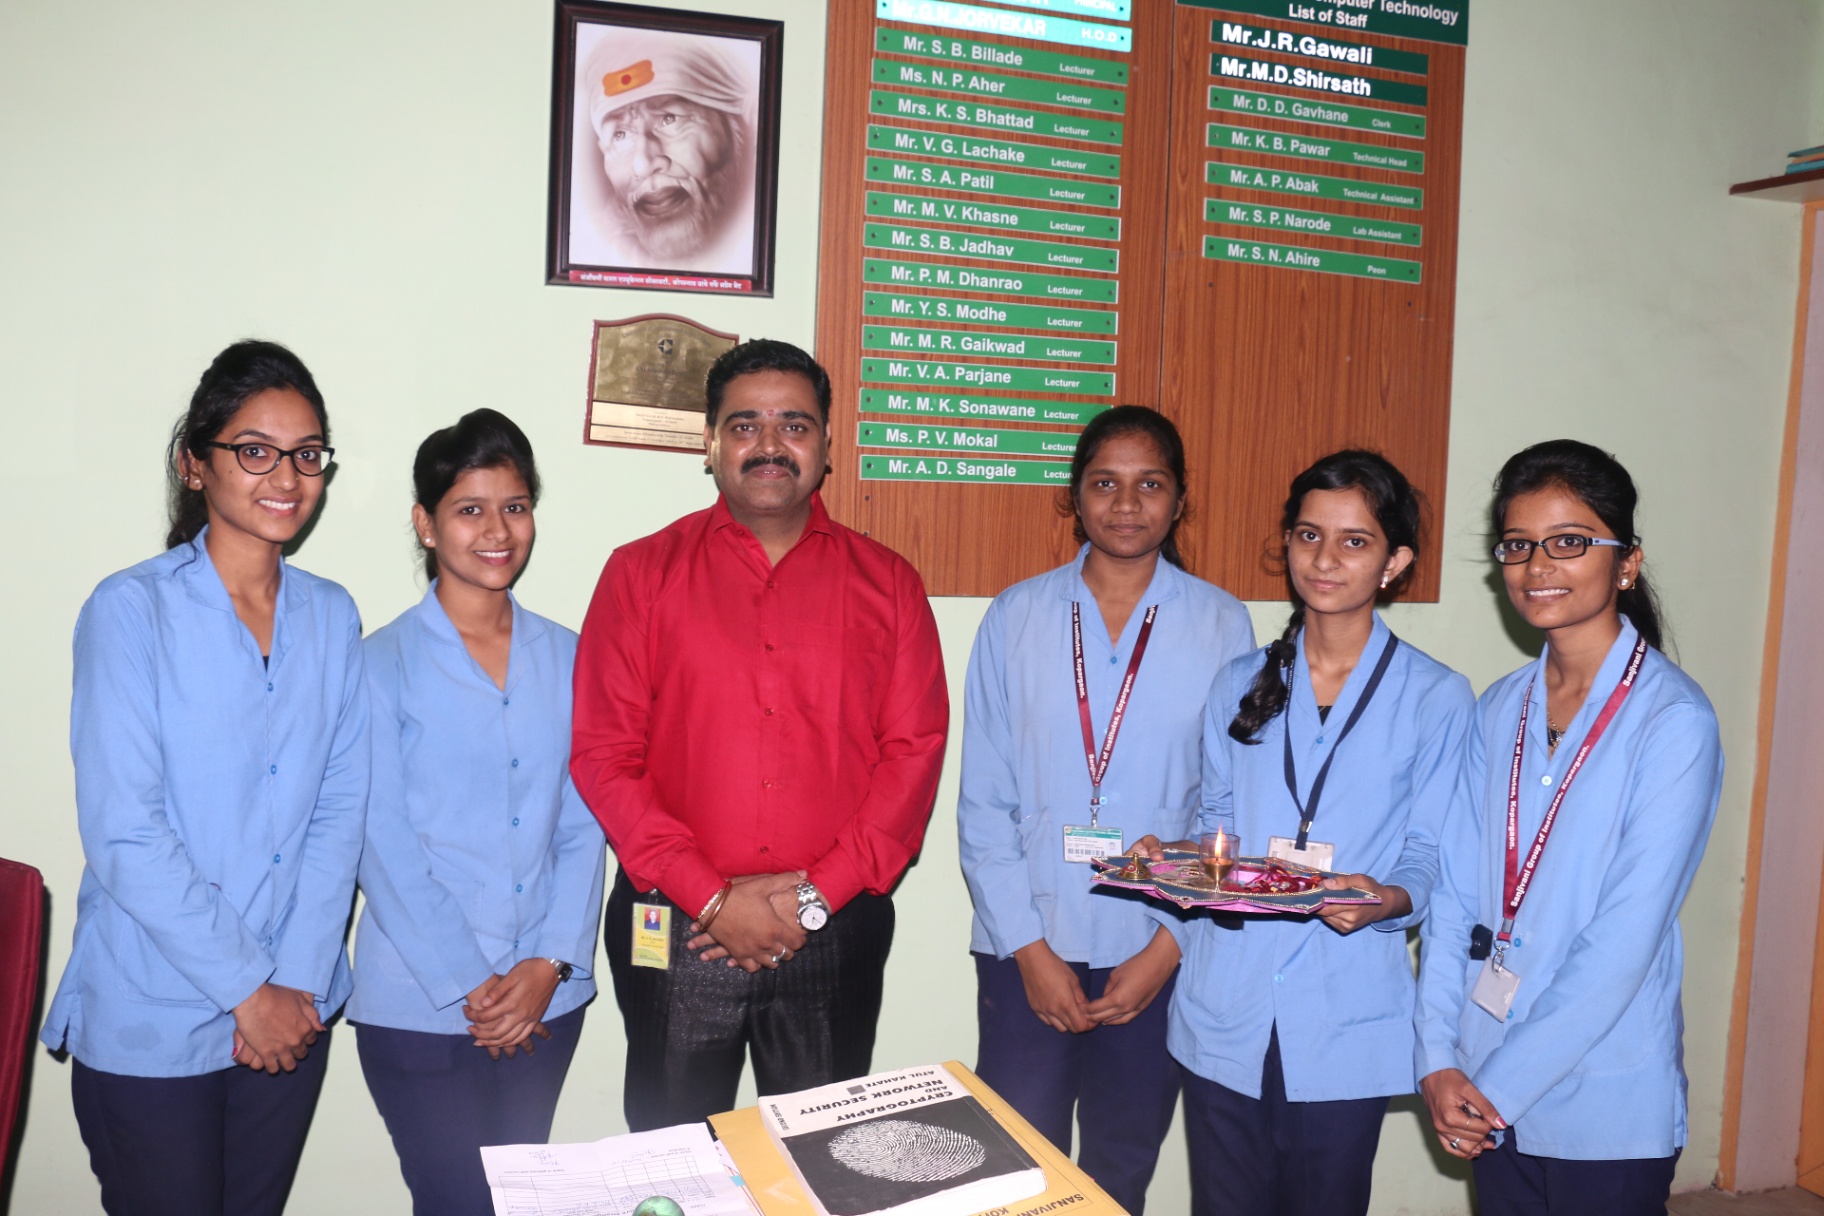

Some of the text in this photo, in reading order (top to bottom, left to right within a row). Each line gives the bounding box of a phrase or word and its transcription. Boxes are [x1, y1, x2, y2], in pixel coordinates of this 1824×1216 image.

[1289, 3, 1368, 28] List of Staff
[1381, 0, 1458, 26] Technology
[904, 36, 1095, 75] Mr. S. B. Billade Lecturer
[1222, 23, 1372, 65] Mr.J.R.Gawali
[900, 66, 1092, 106] Ms. N. P. Aher Lecturer
[1220, 57, 1371, 97] Mr.M.D.Shirsath
[898, 98, 1089, 138] Mrs. K. S. Bhattad Lecturer
[1233, 94, 1391, 128] Mr. D. D. Gavhane Clerk
[895, 133, 1086, 170] Mr. V. G. Lachake Lecturer
[1232, 131, 1407, 167] Mr. K. B. Pawar Technical Head
[894, 164, 1085, 200] Mr. S. A. Patil Lecturer
[1230, 169, 1414, 204] Mr. A. P. Abak Technical Assistant
[894, 199, 1085, 234] Mr. M. V. Khasne Lecturer
[1229, 206, 1402, 239] Mr. S. P. Narode Lab Assistant
[892, 230, 1083, 264] Mr. S. B. Jadhav Lecturer
[1228, 243, 1386, 274] Mr. S. N. Ahire Peon
[891, 266, 1083, 295] Mr. P. M. Dhanrao Lecturer
[891, 299, 1082, 327] Mr. Y. S. Modhe Lecturer
[890, 332, 1081, 357] Mr. M. R. Gaikwad Lecturer
[889, 362, 1080, 387] Mr. V. A. Parjane Lecturer
[888, 395, 1079, 420] Mr. M. K. Sonawane Lecturer
[886, 428, 912, 443] Ms.
[918, 430, 930, 444] P.
[935, 431, 948, 445] V.
[953, 432, 997, 447] Mokal
[889, 459, 1071, 479] Mr. A. D. Sangale Lectur
[1623, 652, 1642, 687] Sanjivani
[1105, 714, 1121, 751] Institutes,
[1096, 760, 1107, 782] Group
[1103, 752, 1109, 760] of
[1507, 719, 1526, 850] Group of Institutes, Kopargaon.
[1510, 745, 1590, 908] Sanjivani Group of Institutes, Kopargaon.
[800, 1079, 943, 1116] NETWORK SECURITY
[865, 1076, 907, 1088] KAHATE
[836, 1091, 953, 1122] CRYPTOGRAPHY
